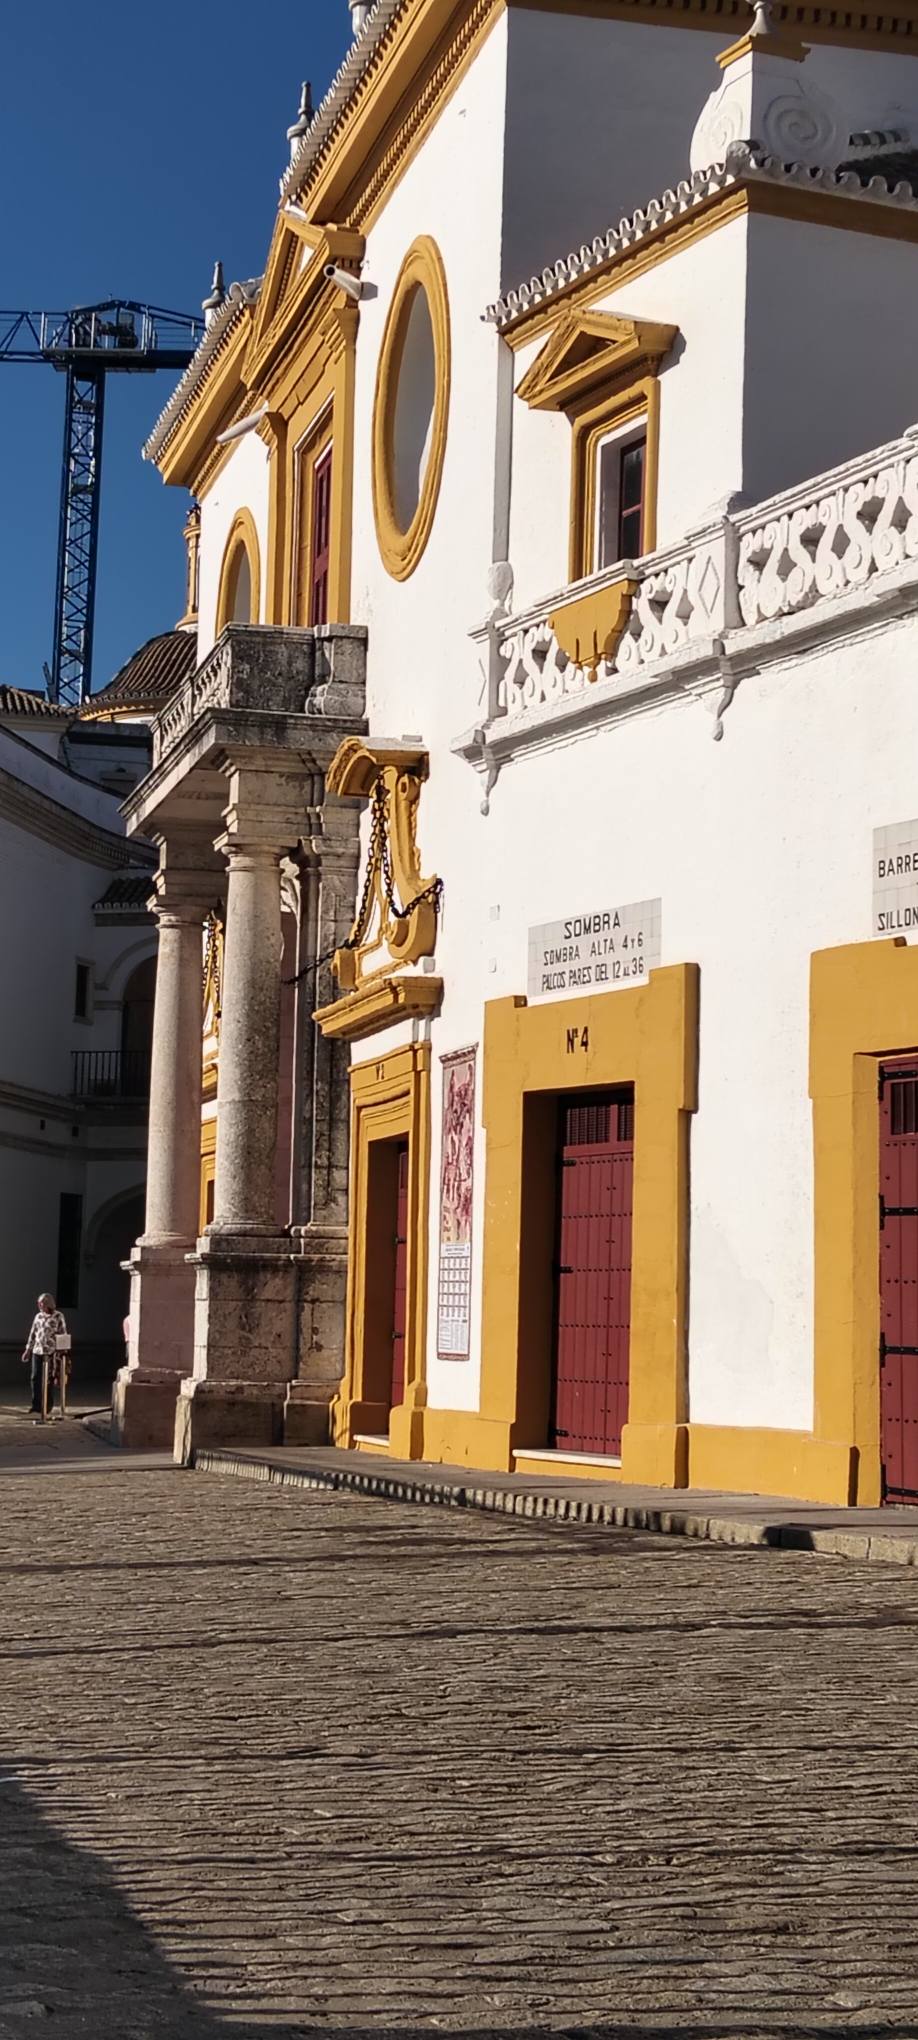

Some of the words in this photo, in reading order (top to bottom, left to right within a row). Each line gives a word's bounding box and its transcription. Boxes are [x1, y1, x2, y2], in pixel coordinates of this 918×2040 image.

[878, 852, 918, 878] BARRE
[564, 911, 621, 939] SOMBRA
[544, 945, 581, 966] SOMBRA
[590, 938, 615, 957] ALTA
[622, 935, 629, 950] 4
[637, 932, 643, 947] 6
[541, 971, 566, 992] PALCOS
[568, 966, 592, 986] PARES
[595, 963, 609, 982] DEL
[613, 961, 620, 979] 12
[632, 957, 644, 975] 36
[580, 1026, 589, 1052] 4
